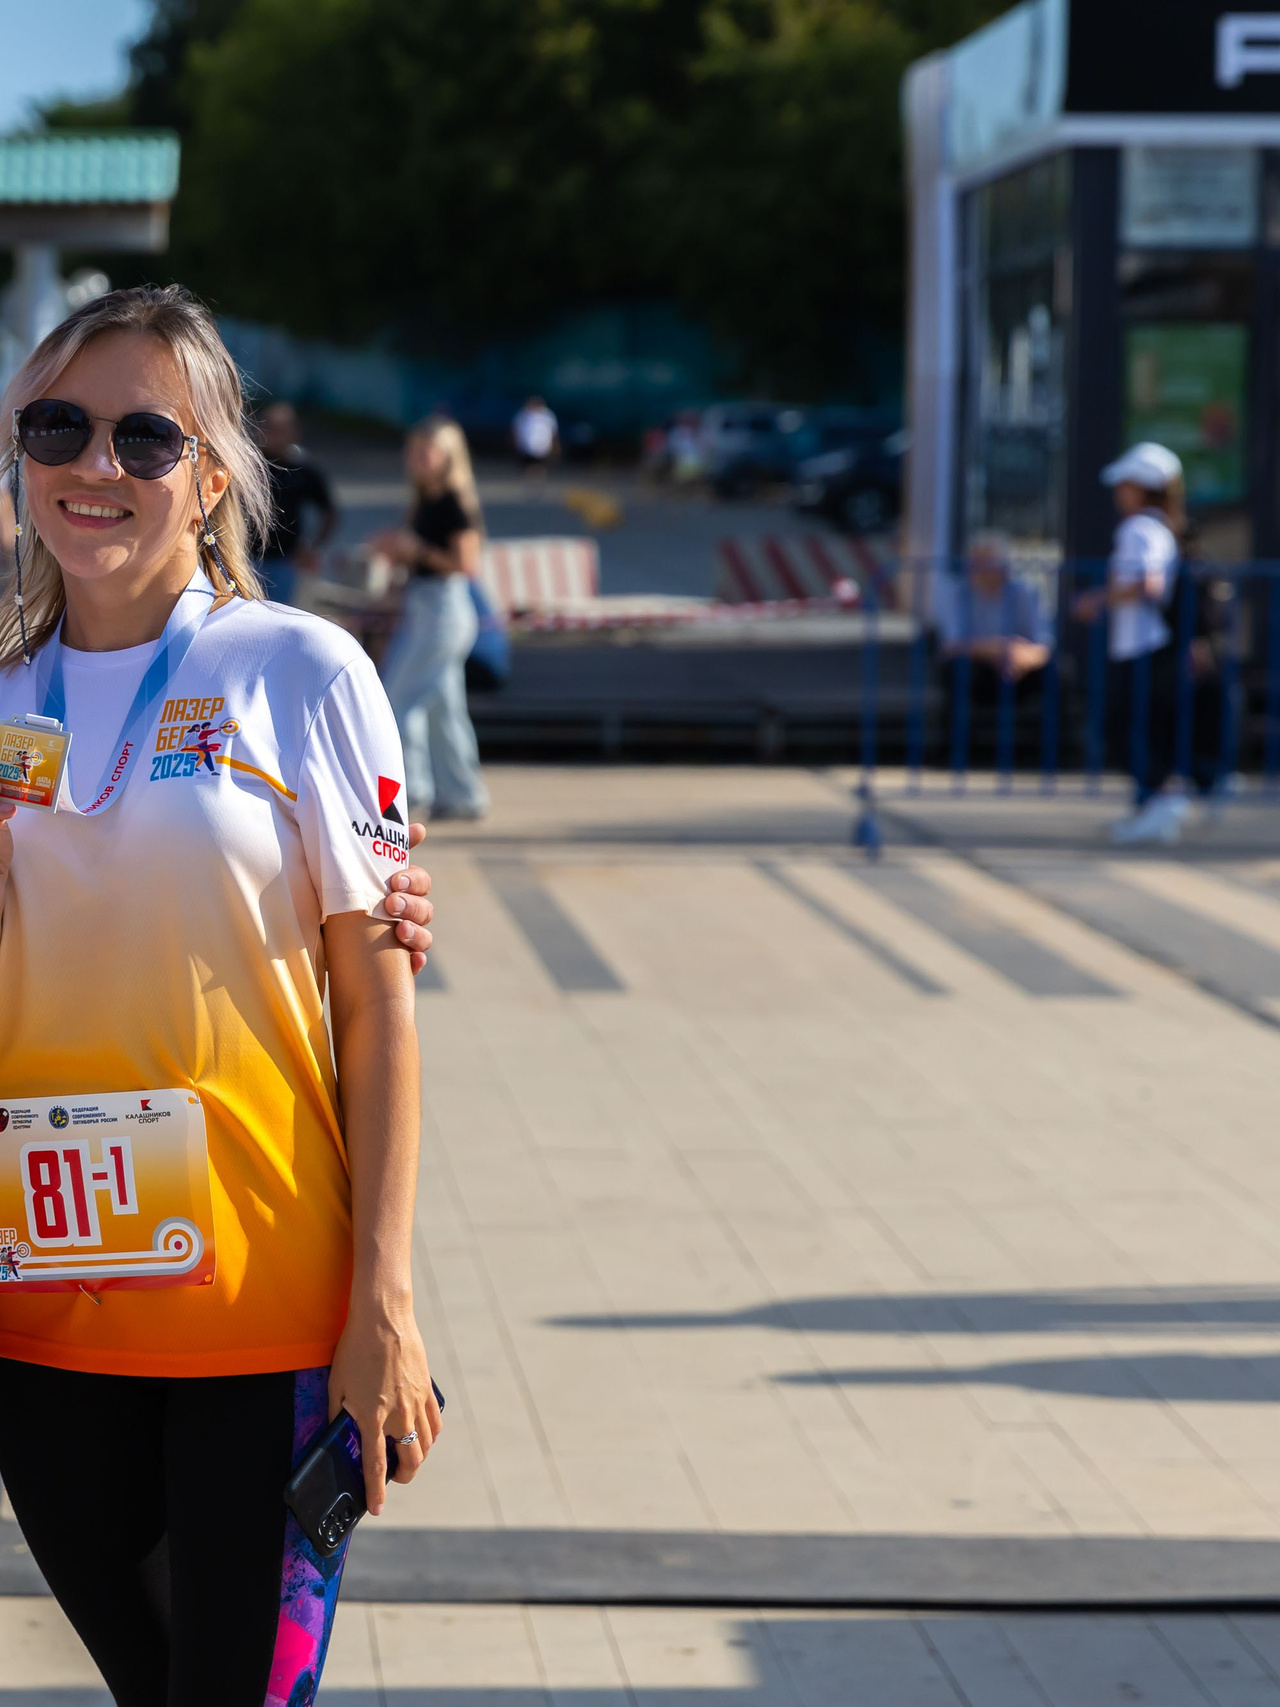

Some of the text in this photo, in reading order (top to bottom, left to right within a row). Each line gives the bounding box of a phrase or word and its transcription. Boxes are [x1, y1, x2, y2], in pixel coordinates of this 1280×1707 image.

[160, 697, 225, 723] ЛАЗЕР
[3, 733, 35, 750] ЛАЗЕР
[155, 726, 191, 752] БЕГ
[111, 741, 133, 782] СПОРТ
[150, 753, 197, 782] 2025
[372, 840, 408, 865] СПОР
[72, 1112, 106, 1120] СОВРЕМЕННОГО
[125, 1111, 171, 1120] КАЛАШНИКОВ
[138, 1117, 160, 1125] СПОРТ
[27, 1145, 128, 1239] 81-1
